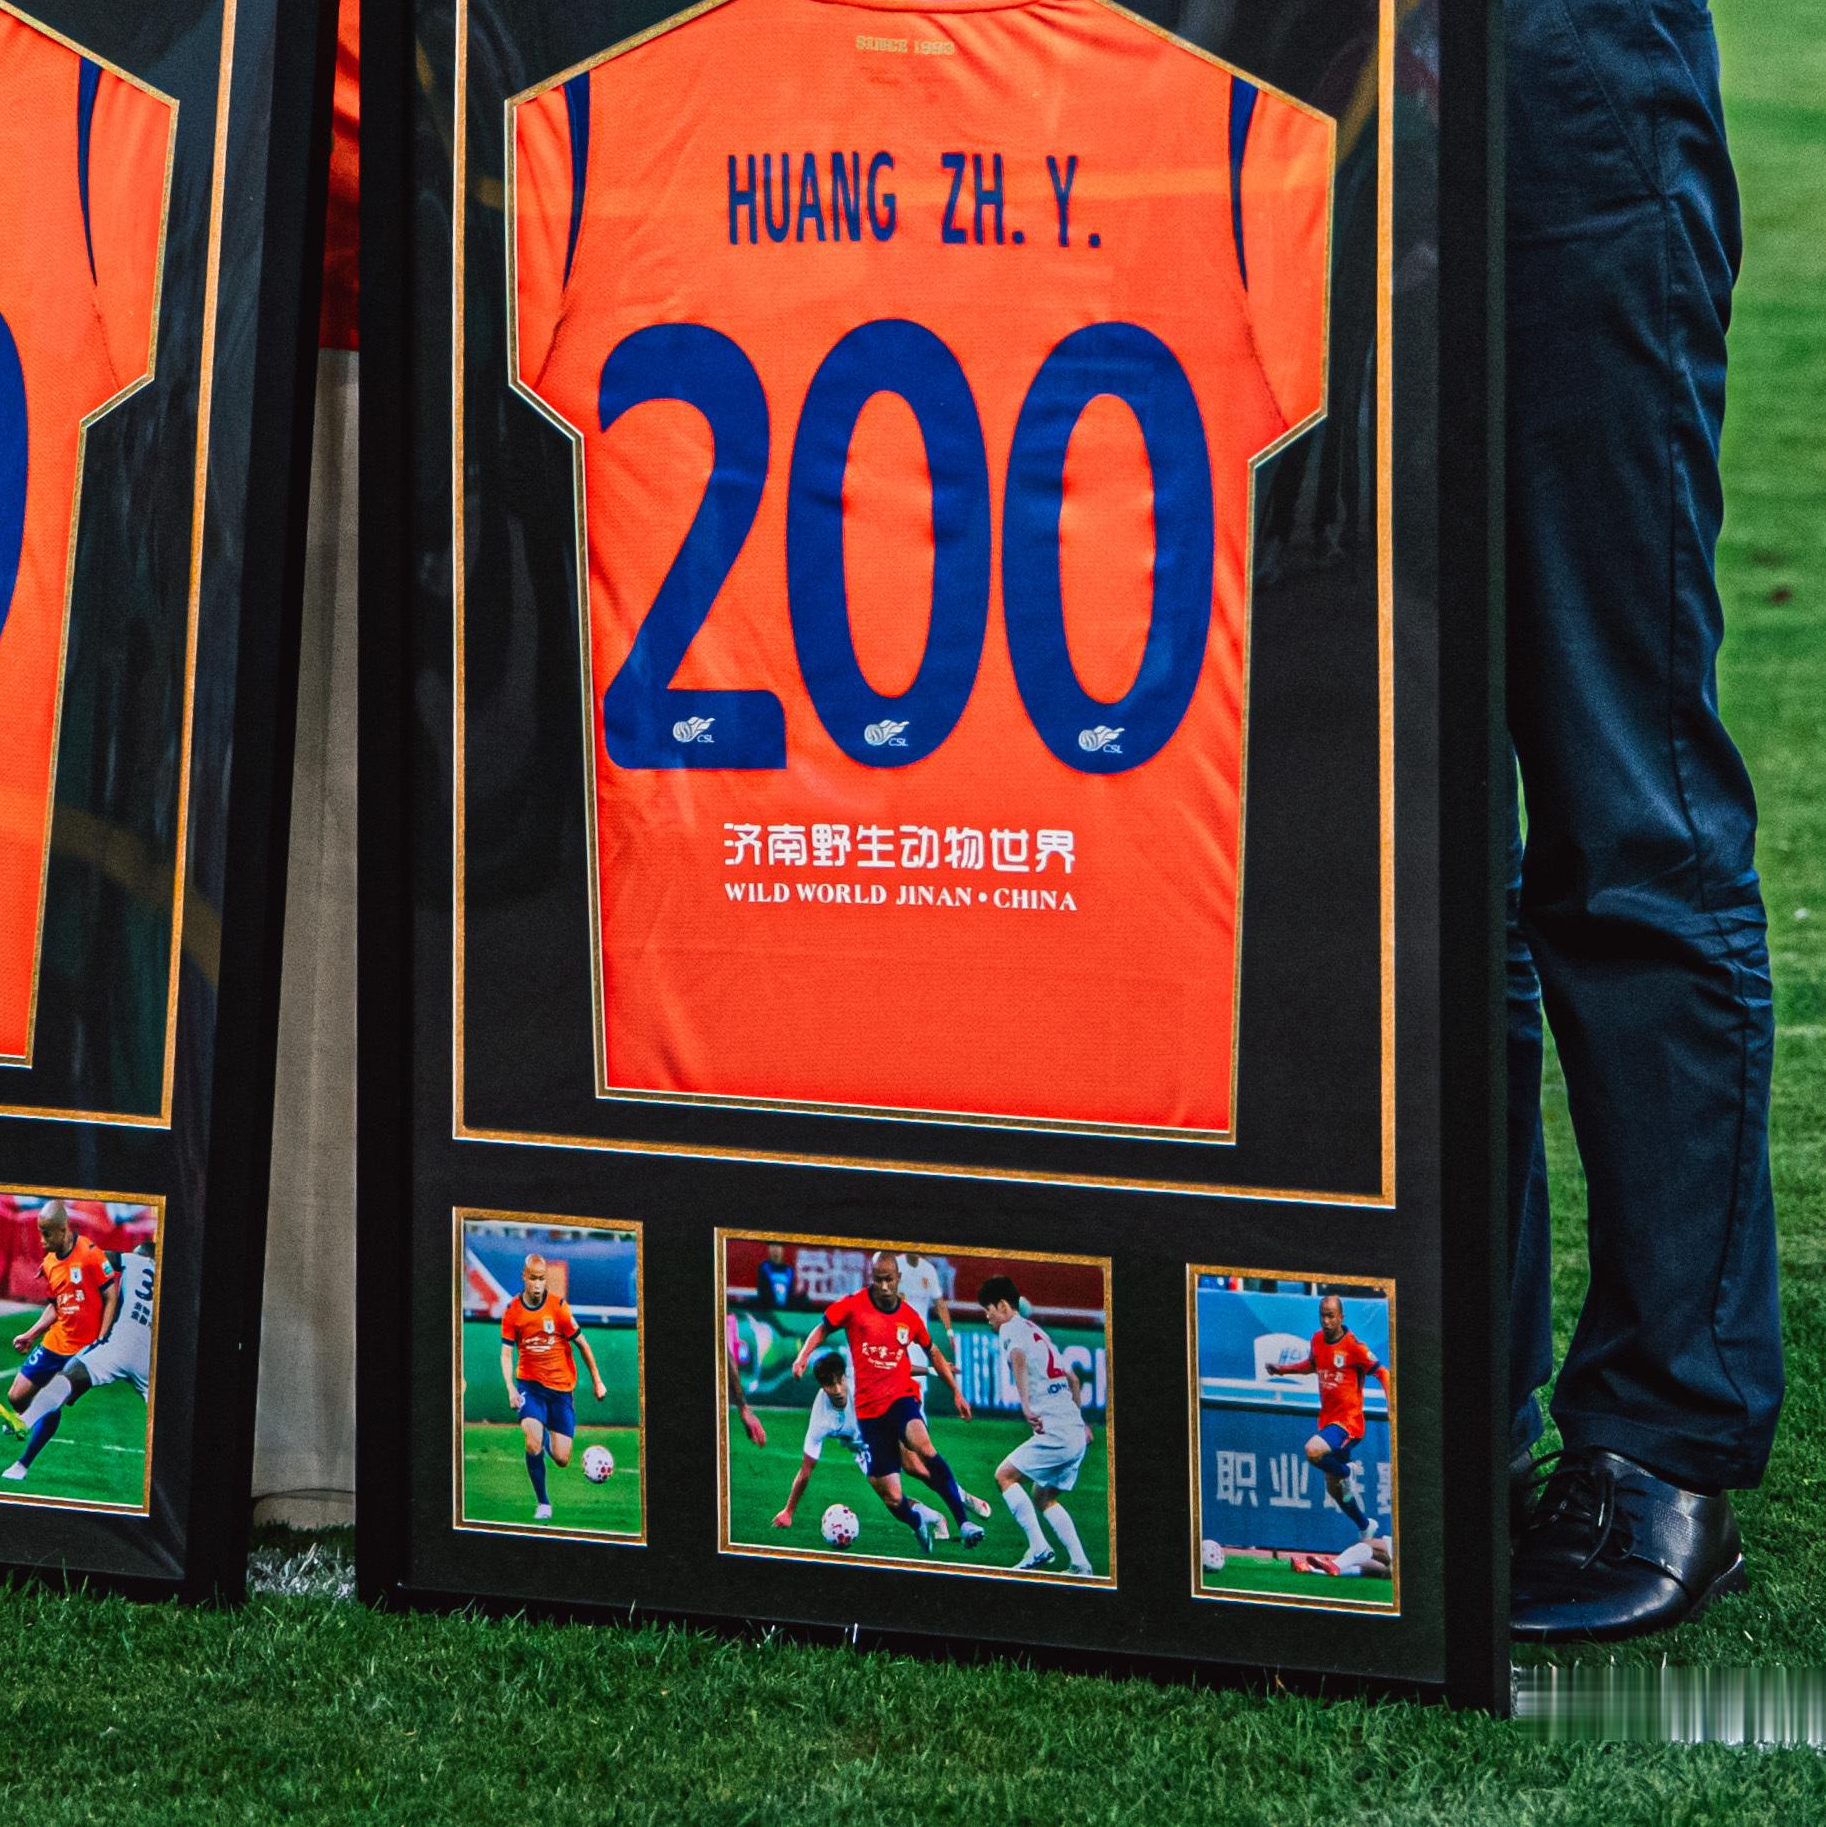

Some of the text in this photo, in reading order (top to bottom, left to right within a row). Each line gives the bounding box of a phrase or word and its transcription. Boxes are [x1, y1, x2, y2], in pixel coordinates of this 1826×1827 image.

[728, 151, 1102, 249] HUANG ZH. Y.
[598, 318, 1214, 774] 200
[723, 821, 1076, 873] 济南野生动物世界
[724, 881, 1078, 912] WILD WORLD JINAN CHINA
